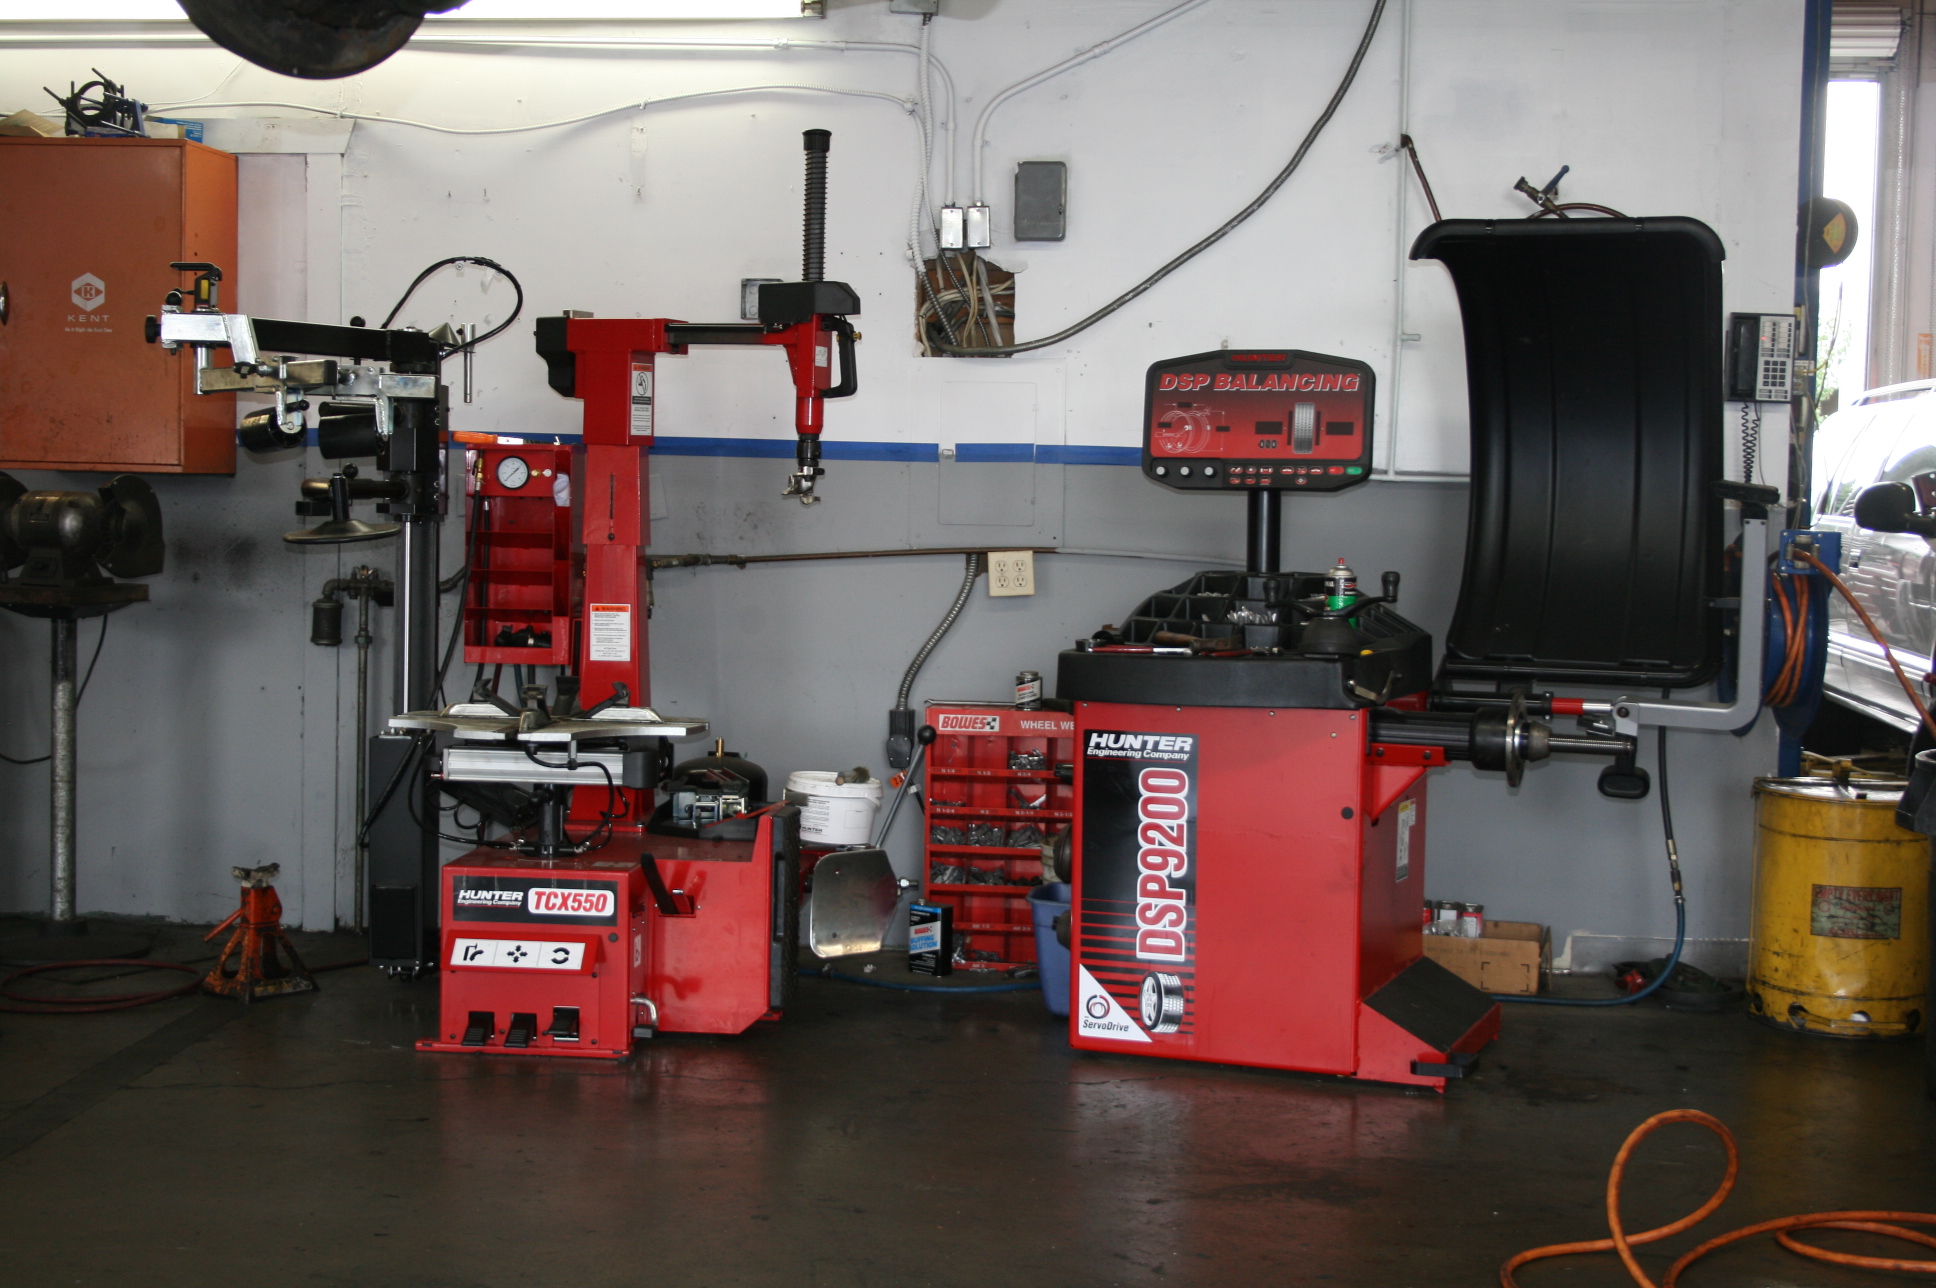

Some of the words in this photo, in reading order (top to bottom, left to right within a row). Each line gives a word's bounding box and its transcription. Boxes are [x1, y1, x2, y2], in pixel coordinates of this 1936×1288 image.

[67, 314, 110, 322] KENT
[1231, 353, 1287, 362] HUNTER
[1159, 373, 1210, 391] DSP
[1213, 373, 1359, 392] BALANCING
[941, 716, 988, 729] BOWES
[1020, 719, 1058, 730] WHEEL
[1089, 733, 1193, 751] HUNTER
[1086, 746, 1142, 759] Engineering
[1143, 749, 1190, 761] Company
[1136, 767, 1189, 962] DSP9200
[458, 890, 524, 901] HUNTER
[534, 890, 608, 913] TCX550
[1083, 1019, 1130, 1032] ServoDrive
